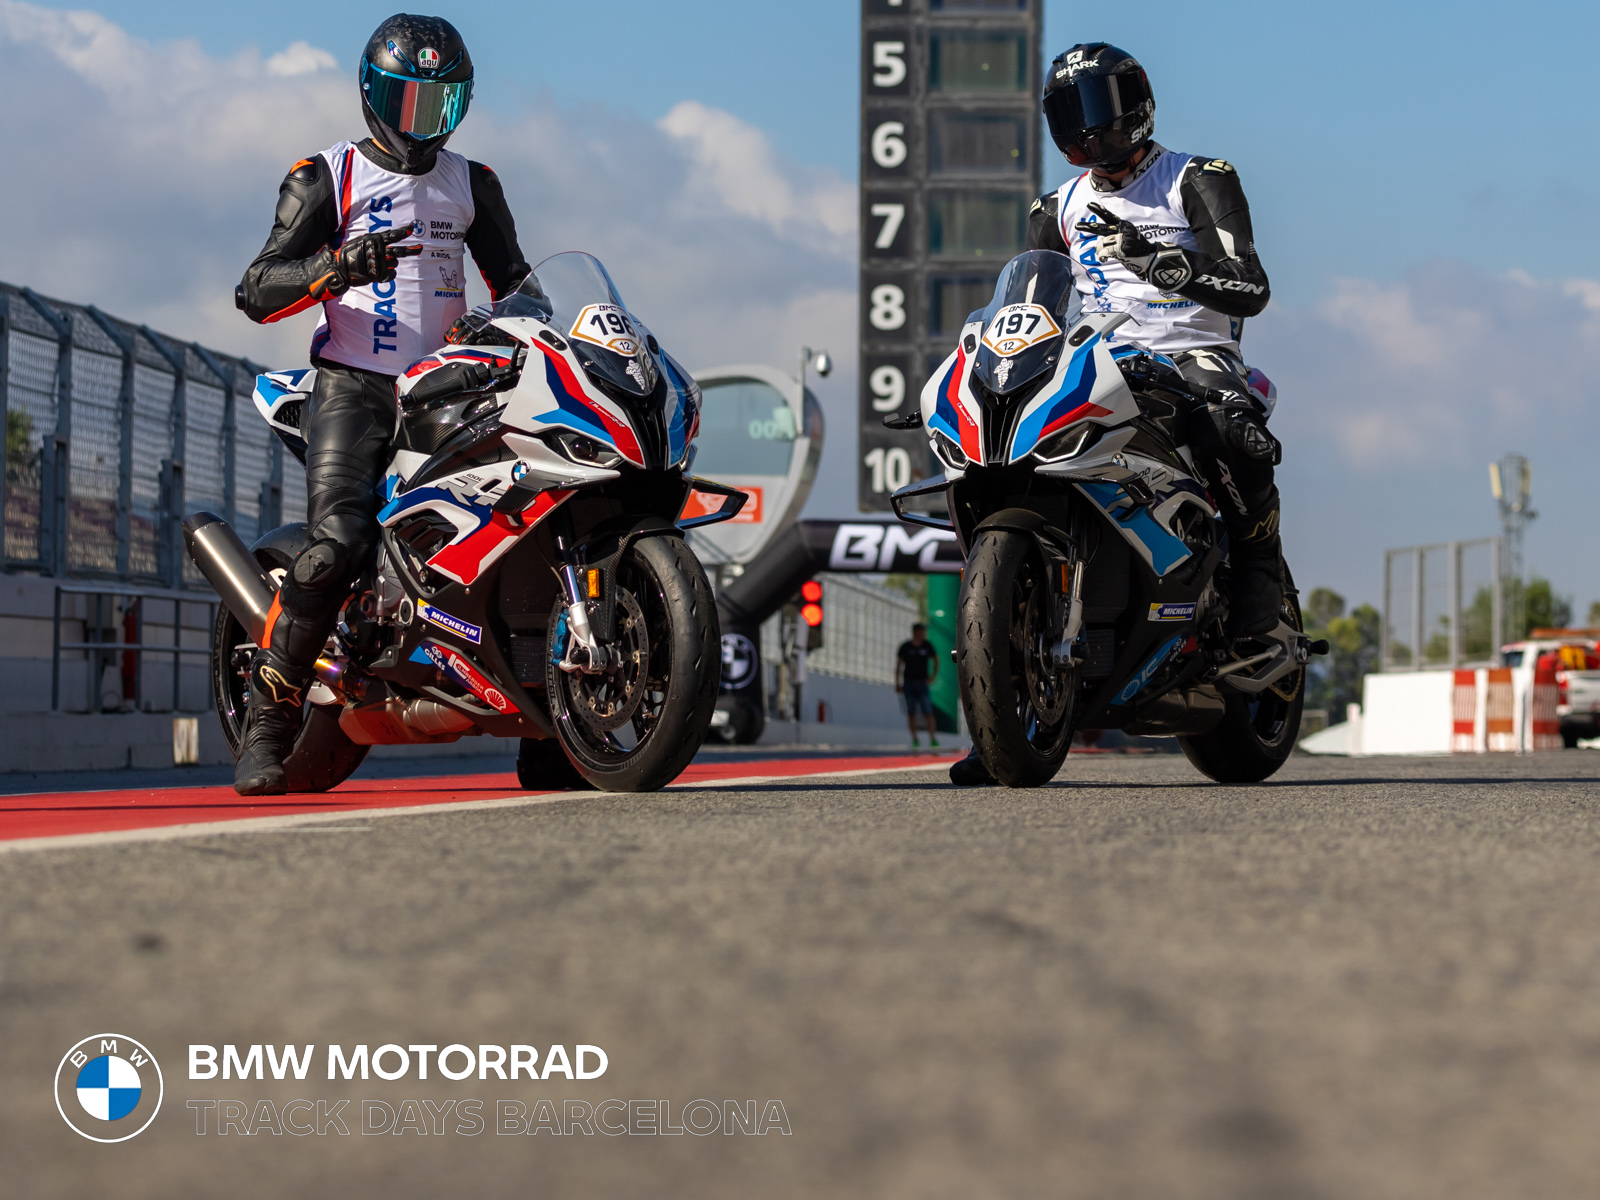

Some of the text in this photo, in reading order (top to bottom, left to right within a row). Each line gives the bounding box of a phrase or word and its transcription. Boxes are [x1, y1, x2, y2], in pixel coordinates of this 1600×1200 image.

[873, 42, 906, 87] 5
[1056, 59, 1099, 79] SHARK
[1131, 114, 1154, 144] SHA
[872, 122, 907, 167] 6
[431, 221, 452, 230] BMW
[871, 205, 905, 248] 7
[373, 280, 397, 355] TRAC
[871, 285, 906, 329] 8
[590, 313, 638, 338] 196
[995, 313, 1041, 338] 197
[619, 341, 632, 351] 12
[1003, 341, 1014, 351] 12
[871, 367, 905, 412] 9
[865, 448, 912, 493] 10
[829, 524, 963, 570] BMC
[215, 604, 227, 645] MICHE
[431, 611, 478, 636] MICHELIN
[1163, 607, 1193, 615] MICHELIN
[424, 648, 446, 671] GILLES
